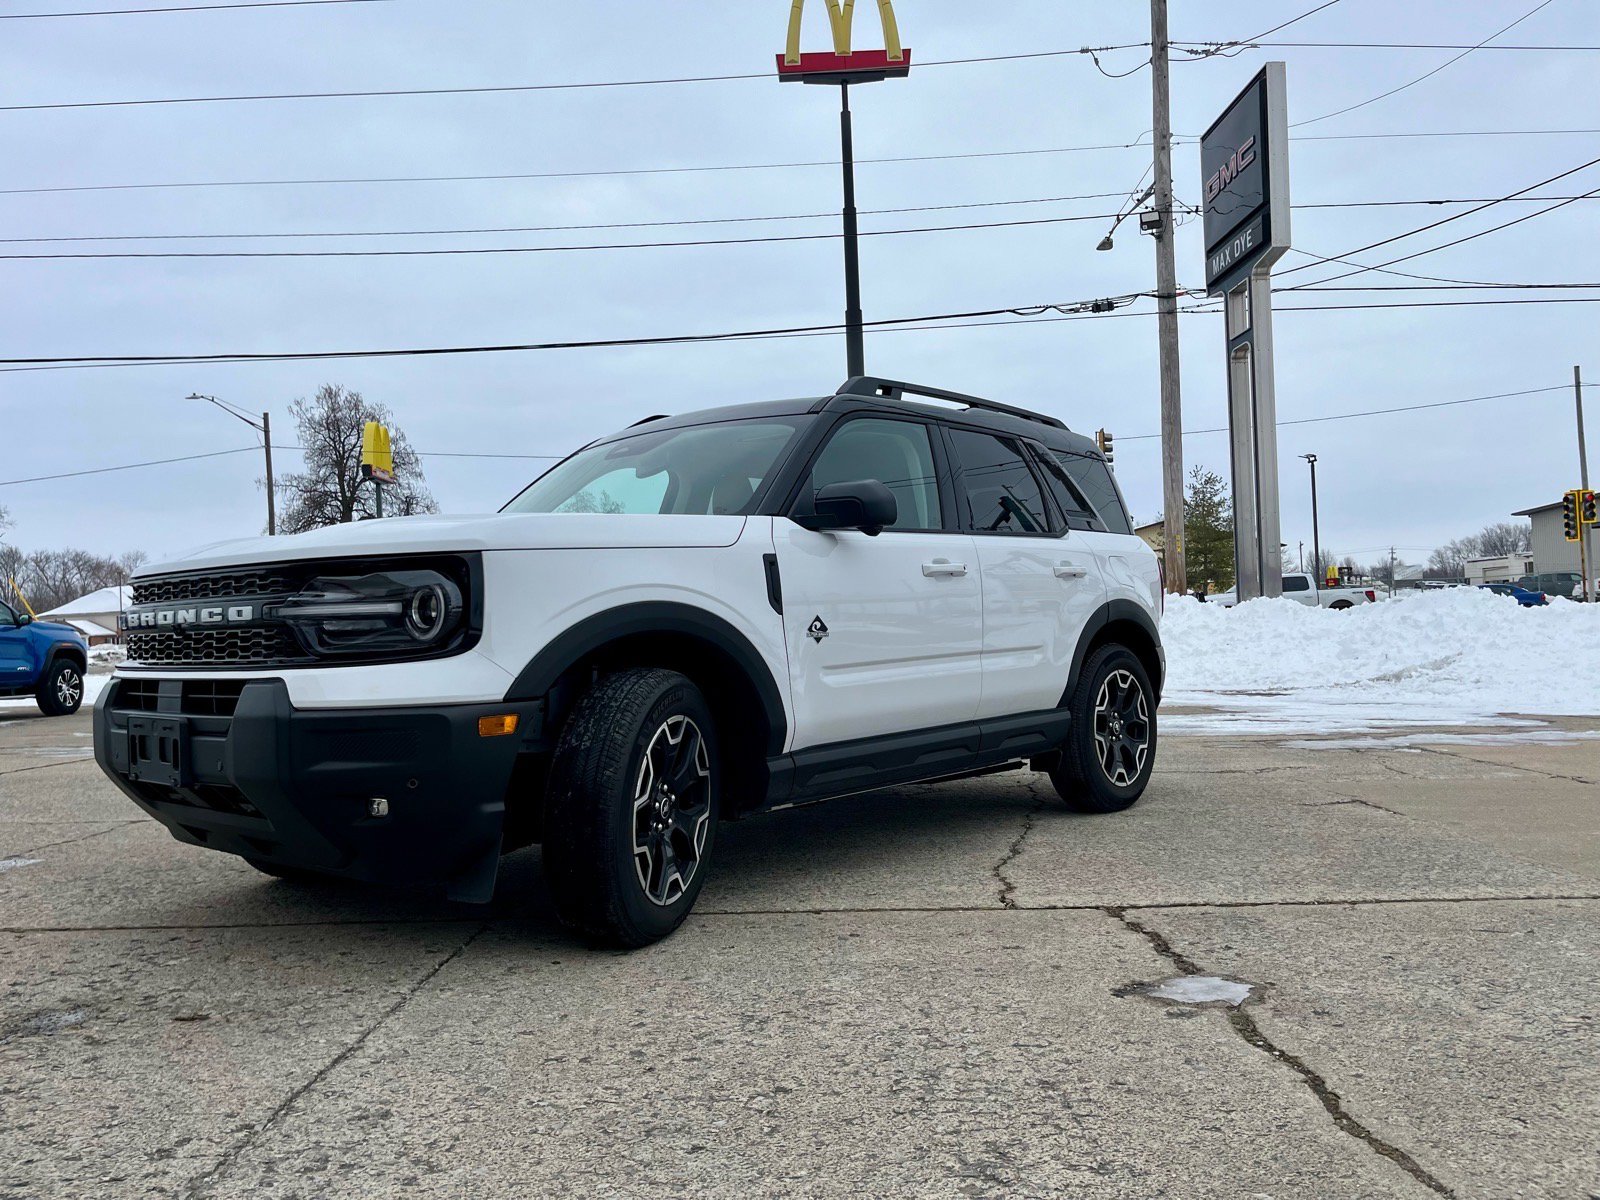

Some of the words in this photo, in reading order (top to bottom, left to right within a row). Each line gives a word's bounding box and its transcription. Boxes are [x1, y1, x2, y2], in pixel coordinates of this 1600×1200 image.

[1205, 135, 1256, 203] GMC
[1212, 246, 1231, 276] MAX
[1234, 228, 1253, 258] DYE
[127, 605, 253, 628] BRONCO
